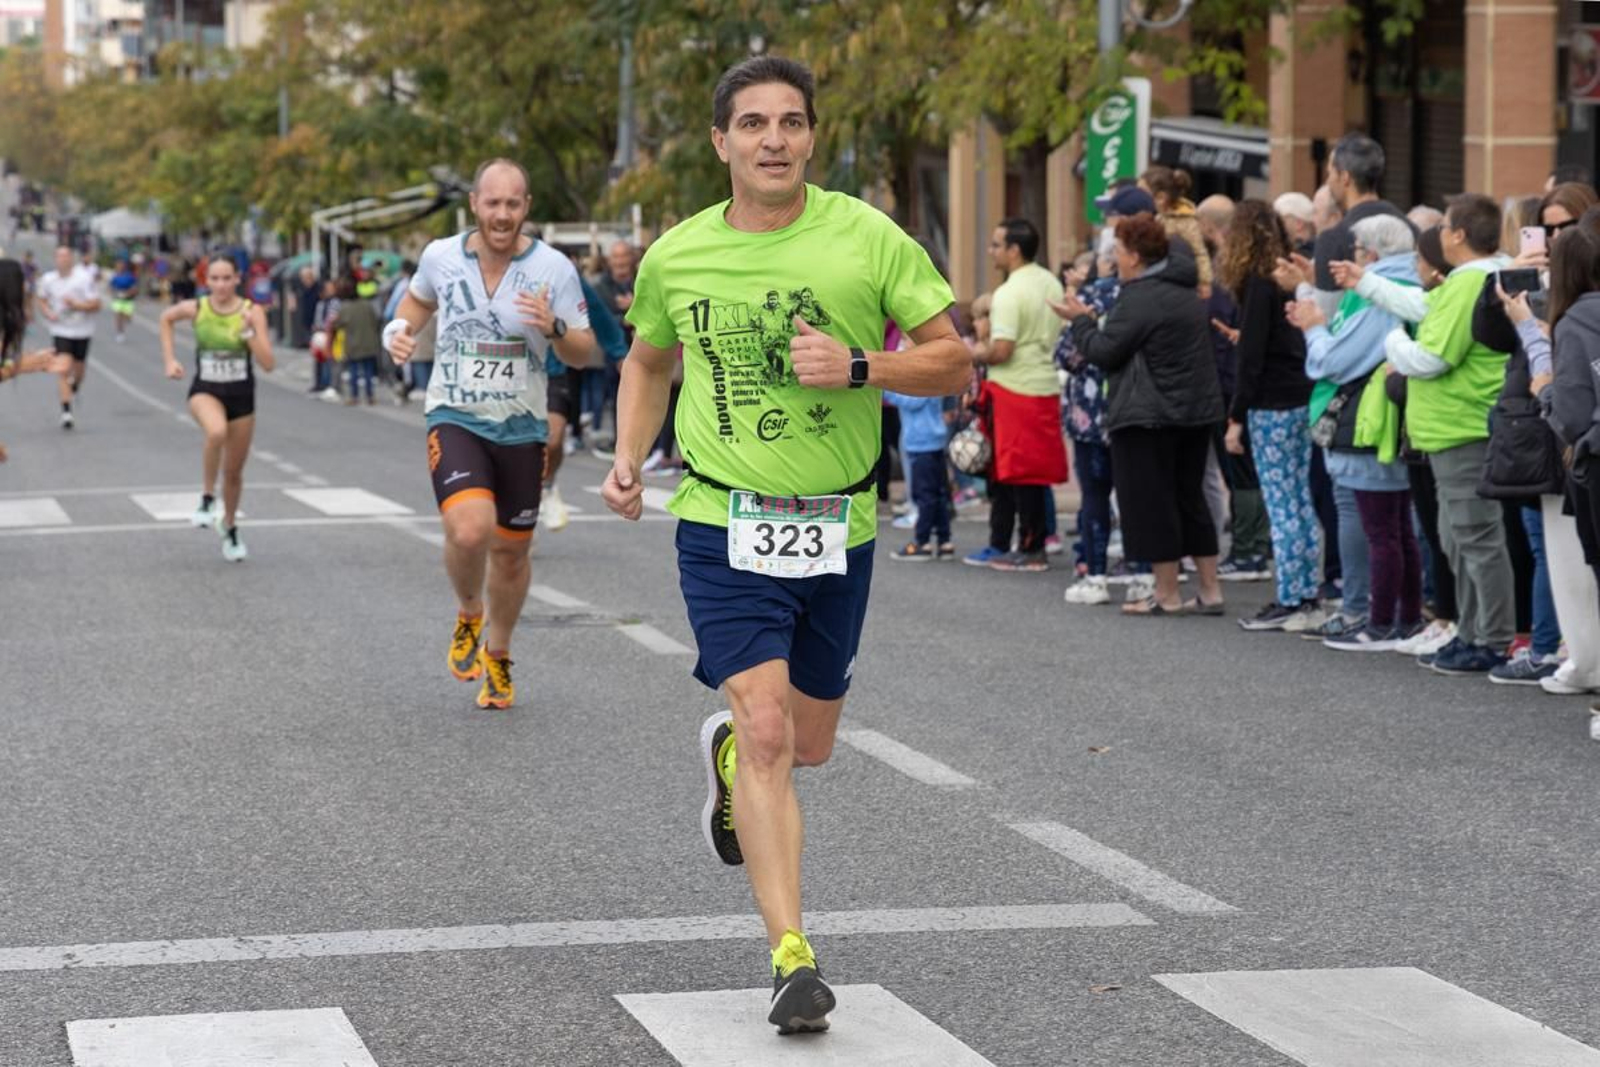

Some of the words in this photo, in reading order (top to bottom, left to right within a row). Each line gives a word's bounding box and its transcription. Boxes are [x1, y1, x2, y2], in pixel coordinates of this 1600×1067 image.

[689, 299, 710, 333] 17
[713, 302, 749, 331] XI
[473, 359, 514, 380] 274
[699, 337, 734, 436] noviembre
[763, 418, 790, 431] CSIF
[753, 523, 824, 558] 323
